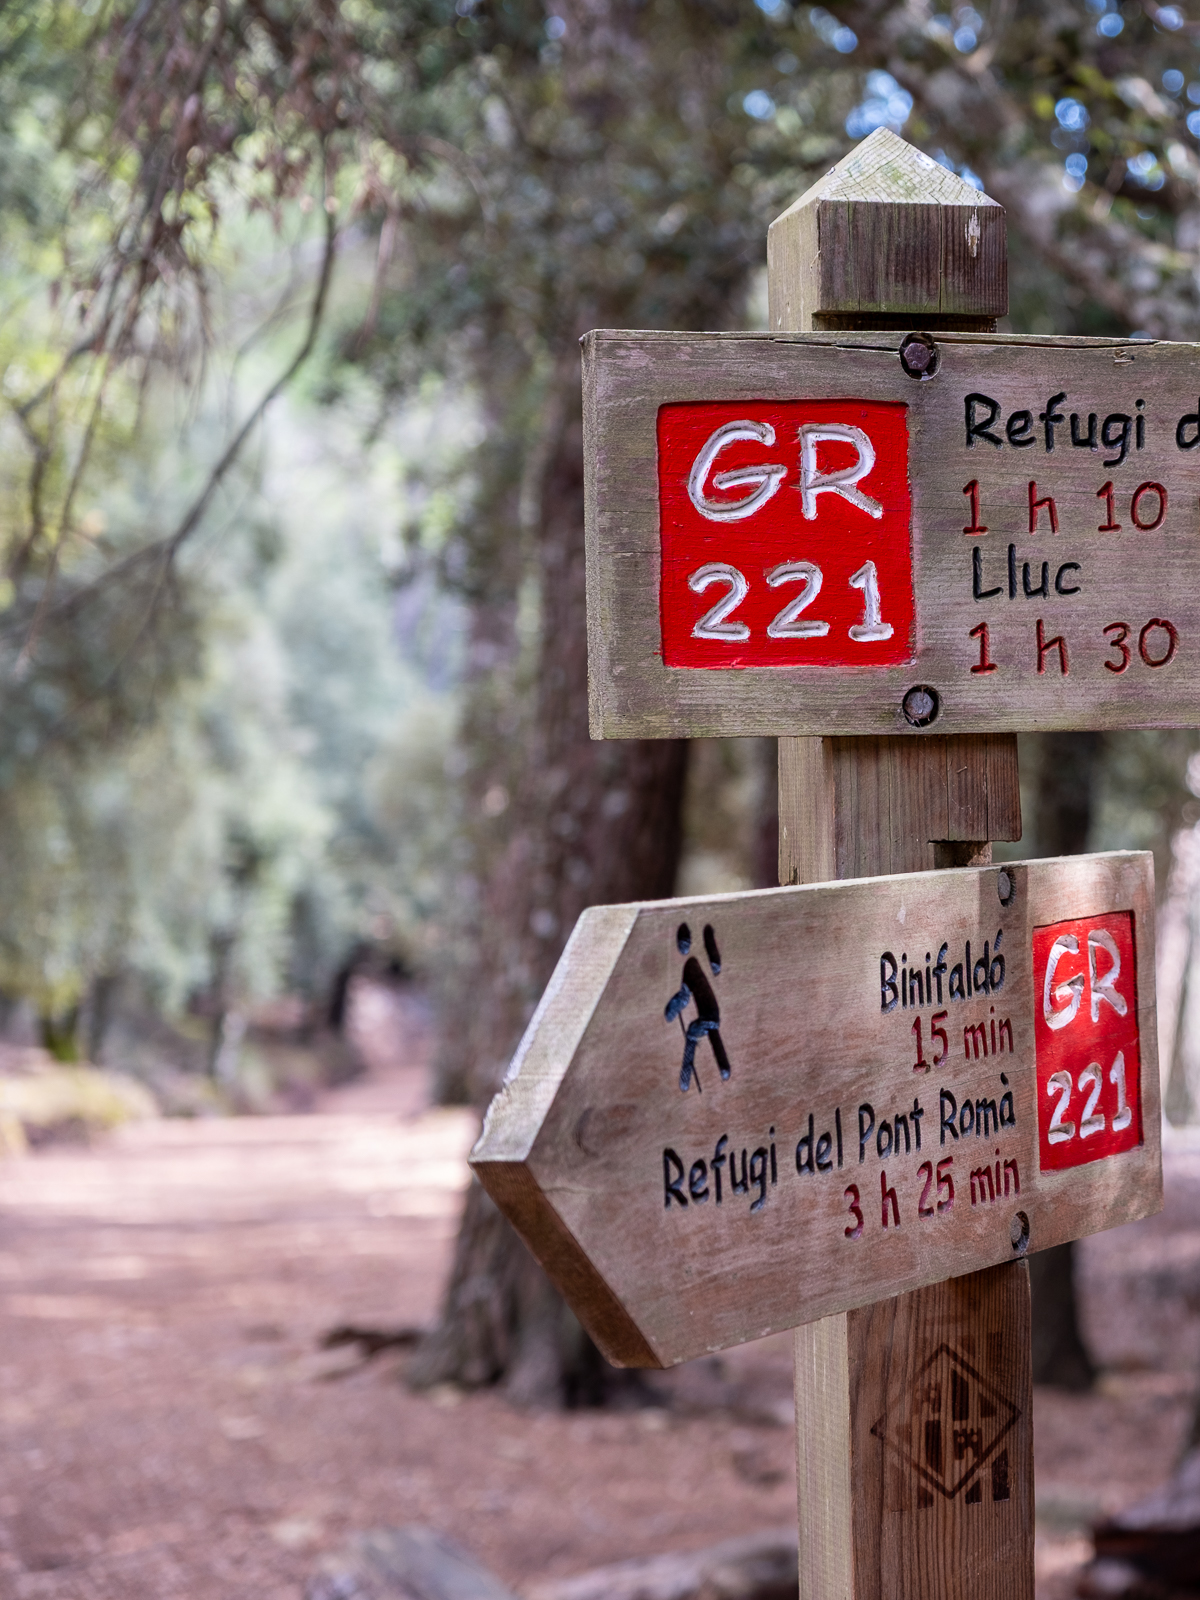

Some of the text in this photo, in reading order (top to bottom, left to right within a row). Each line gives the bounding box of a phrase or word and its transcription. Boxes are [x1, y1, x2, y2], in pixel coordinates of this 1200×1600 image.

[686, 419, 884, 522] GR
[963, 392, 1148, 467] Refugi
[961, 479, 988, 537] 1
[1027, 480, 1058, 535] h
[1097, 481, 1168, 534] 10
[688, 558, 895, 644] 221
[972, 543, 1081, 601] Lluc
[969, 621, 998, 677] 1
[1035, 619, 1069, 677] h
[1104, 618, 1179, 675] 30
[880, 929, 1006, 1015] Binifaldó
[1042, 928, 1128, 1032] GR
[911, 1006, 1014, 1073] 15 min
[1046, 1050, 1132, 1146] 221
[663, 1072, 1016, 1214] Refugi del Pont Romà
[844, 1147, 1021, 1240] 3 h 25 min
